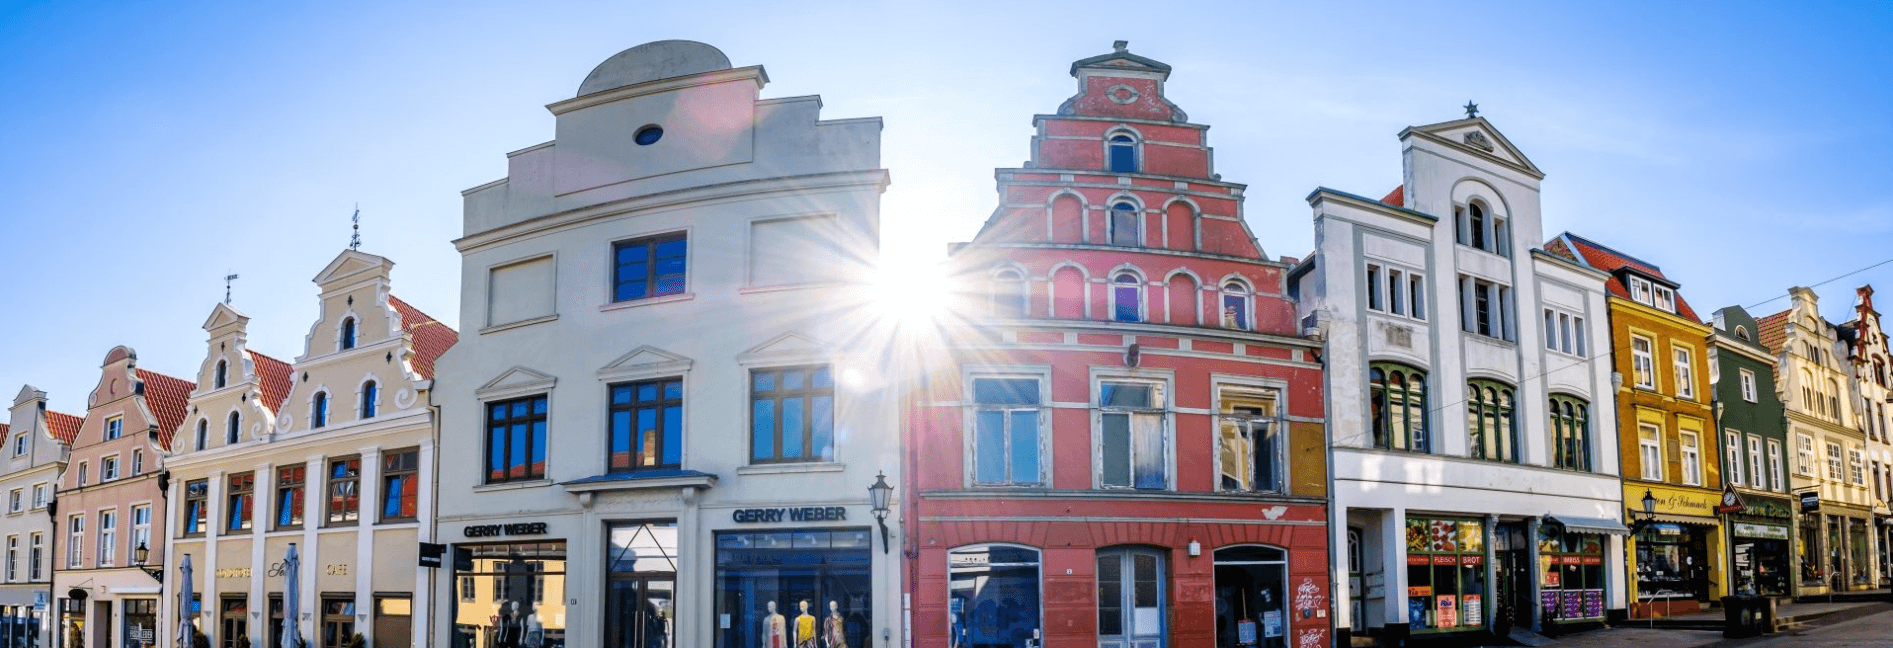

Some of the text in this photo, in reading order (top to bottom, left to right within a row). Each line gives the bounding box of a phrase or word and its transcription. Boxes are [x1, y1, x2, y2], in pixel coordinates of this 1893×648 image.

[733, 506, 846, 523] GERRY WEBER
[463, 522, 547, 537] GERRY WEBER
[1462, 556, 1480, 564] BROT
